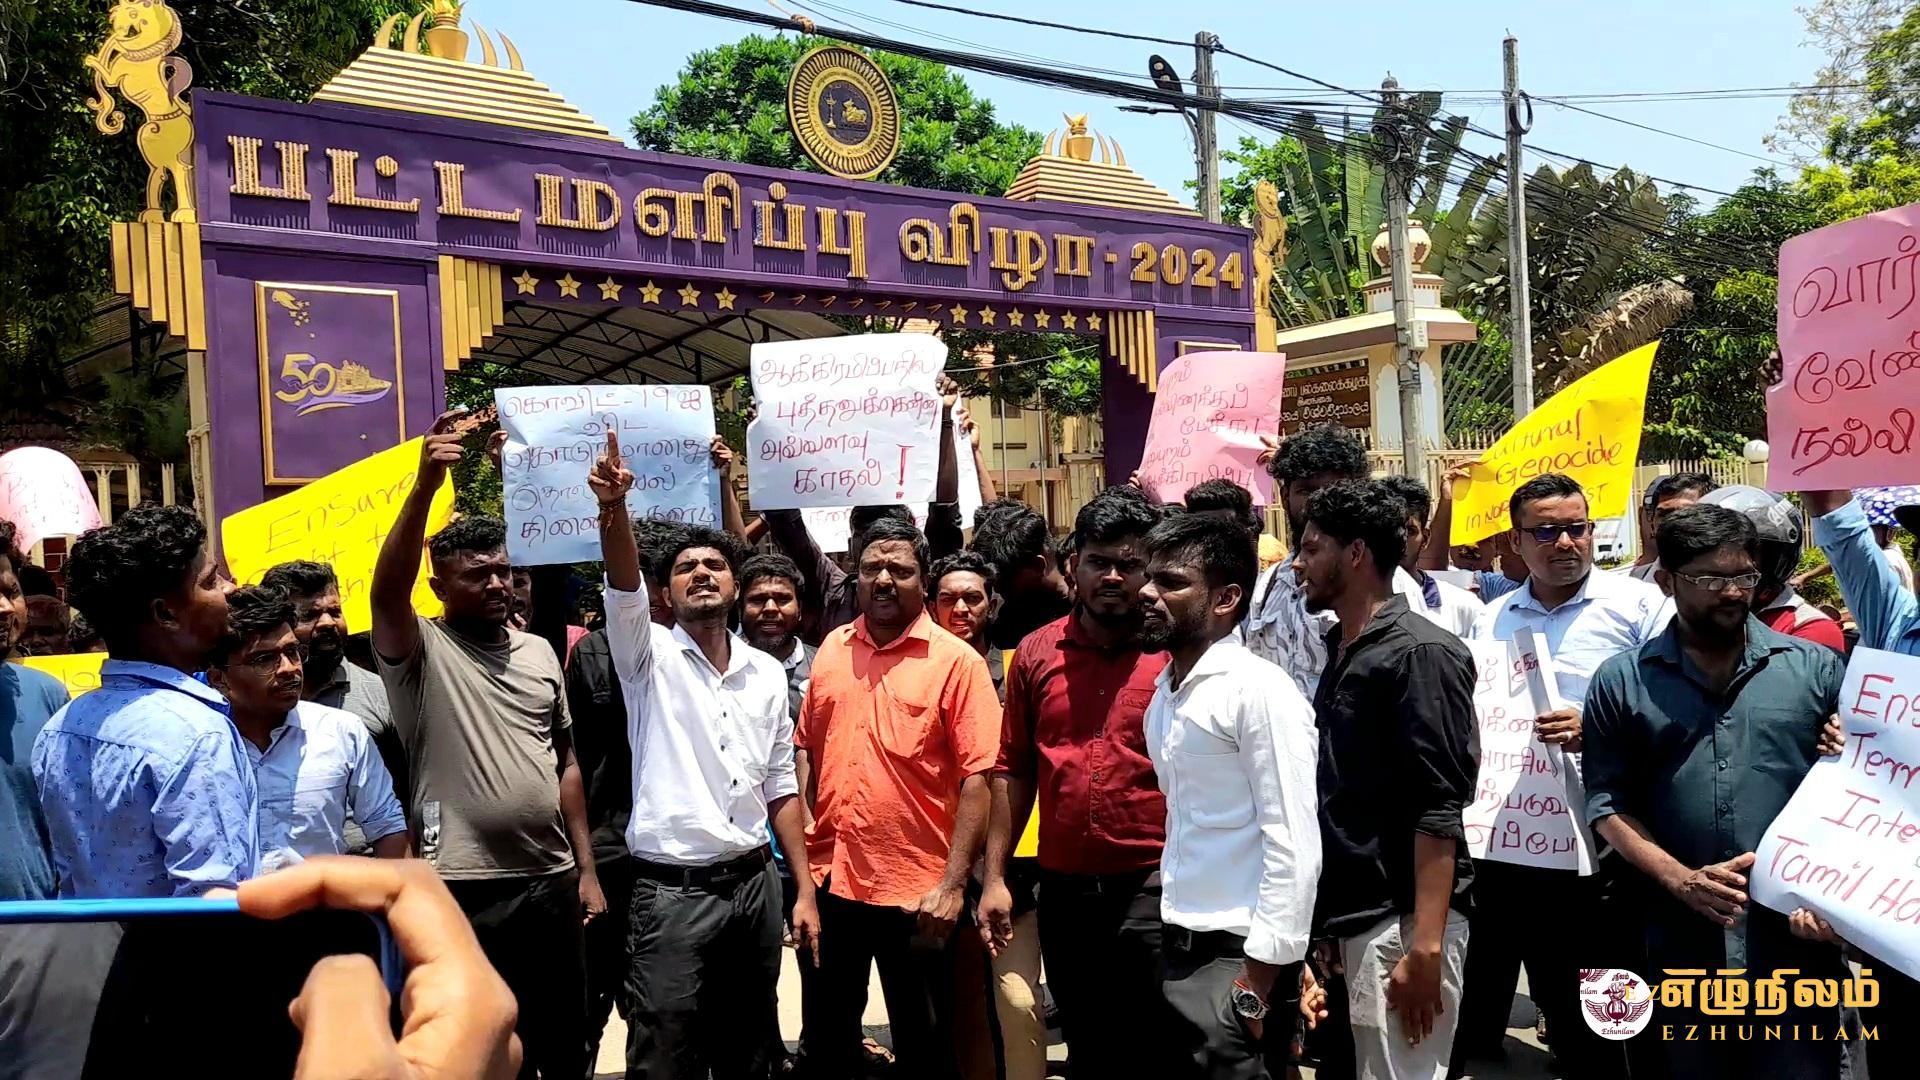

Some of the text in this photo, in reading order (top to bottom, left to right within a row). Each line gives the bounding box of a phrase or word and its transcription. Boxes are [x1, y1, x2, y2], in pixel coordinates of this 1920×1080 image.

[227, 135, 869, 280] பட்டமளிப்பு
[899, 202, 1095, 291] விழா
[1130, 240, 1245, 290] 2024
[274, 352, 337, 404] 50
[793, 457, 883, 498] காதல்
[1495, 434, 1623, 488] Genocide
[265, 471, 419, 554] Ensure
[1769, 834, 1874, 903] Tamil
